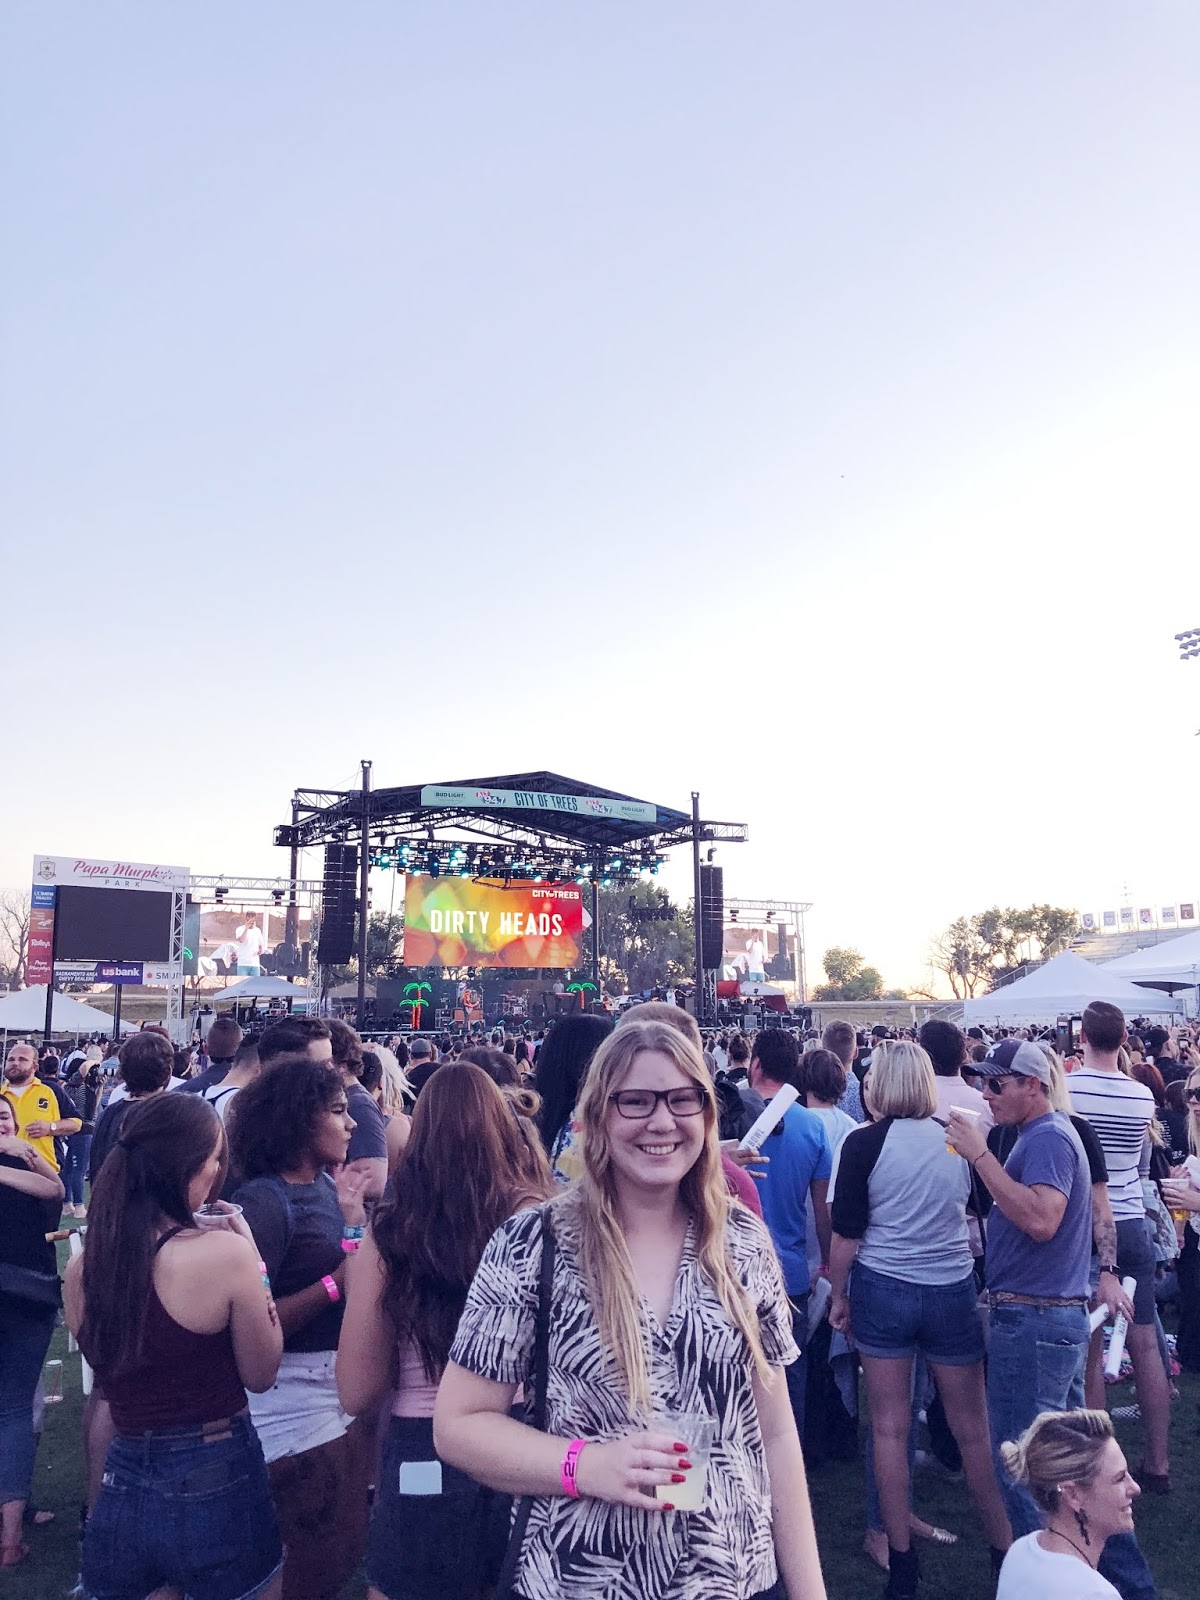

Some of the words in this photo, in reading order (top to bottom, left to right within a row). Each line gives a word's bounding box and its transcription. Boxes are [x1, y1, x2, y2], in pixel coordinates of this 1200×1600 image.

[514, 792, 535, 806] CITY
[537, 794, 549, 807] OF
[550, 795, 578, 811] TREES
[73, 860, 109, 880] Papa
[113, 863, 175, 882] Murph
[105, 879, 141, 888] PARK
[532, 890, 549, 898] CITY
[553, 891, 579, 899] TREES
[430, 909, 490, 934] DIRTY
[500, 911, 563, 936] HEADS
[115, 967, 140, 976] bank
